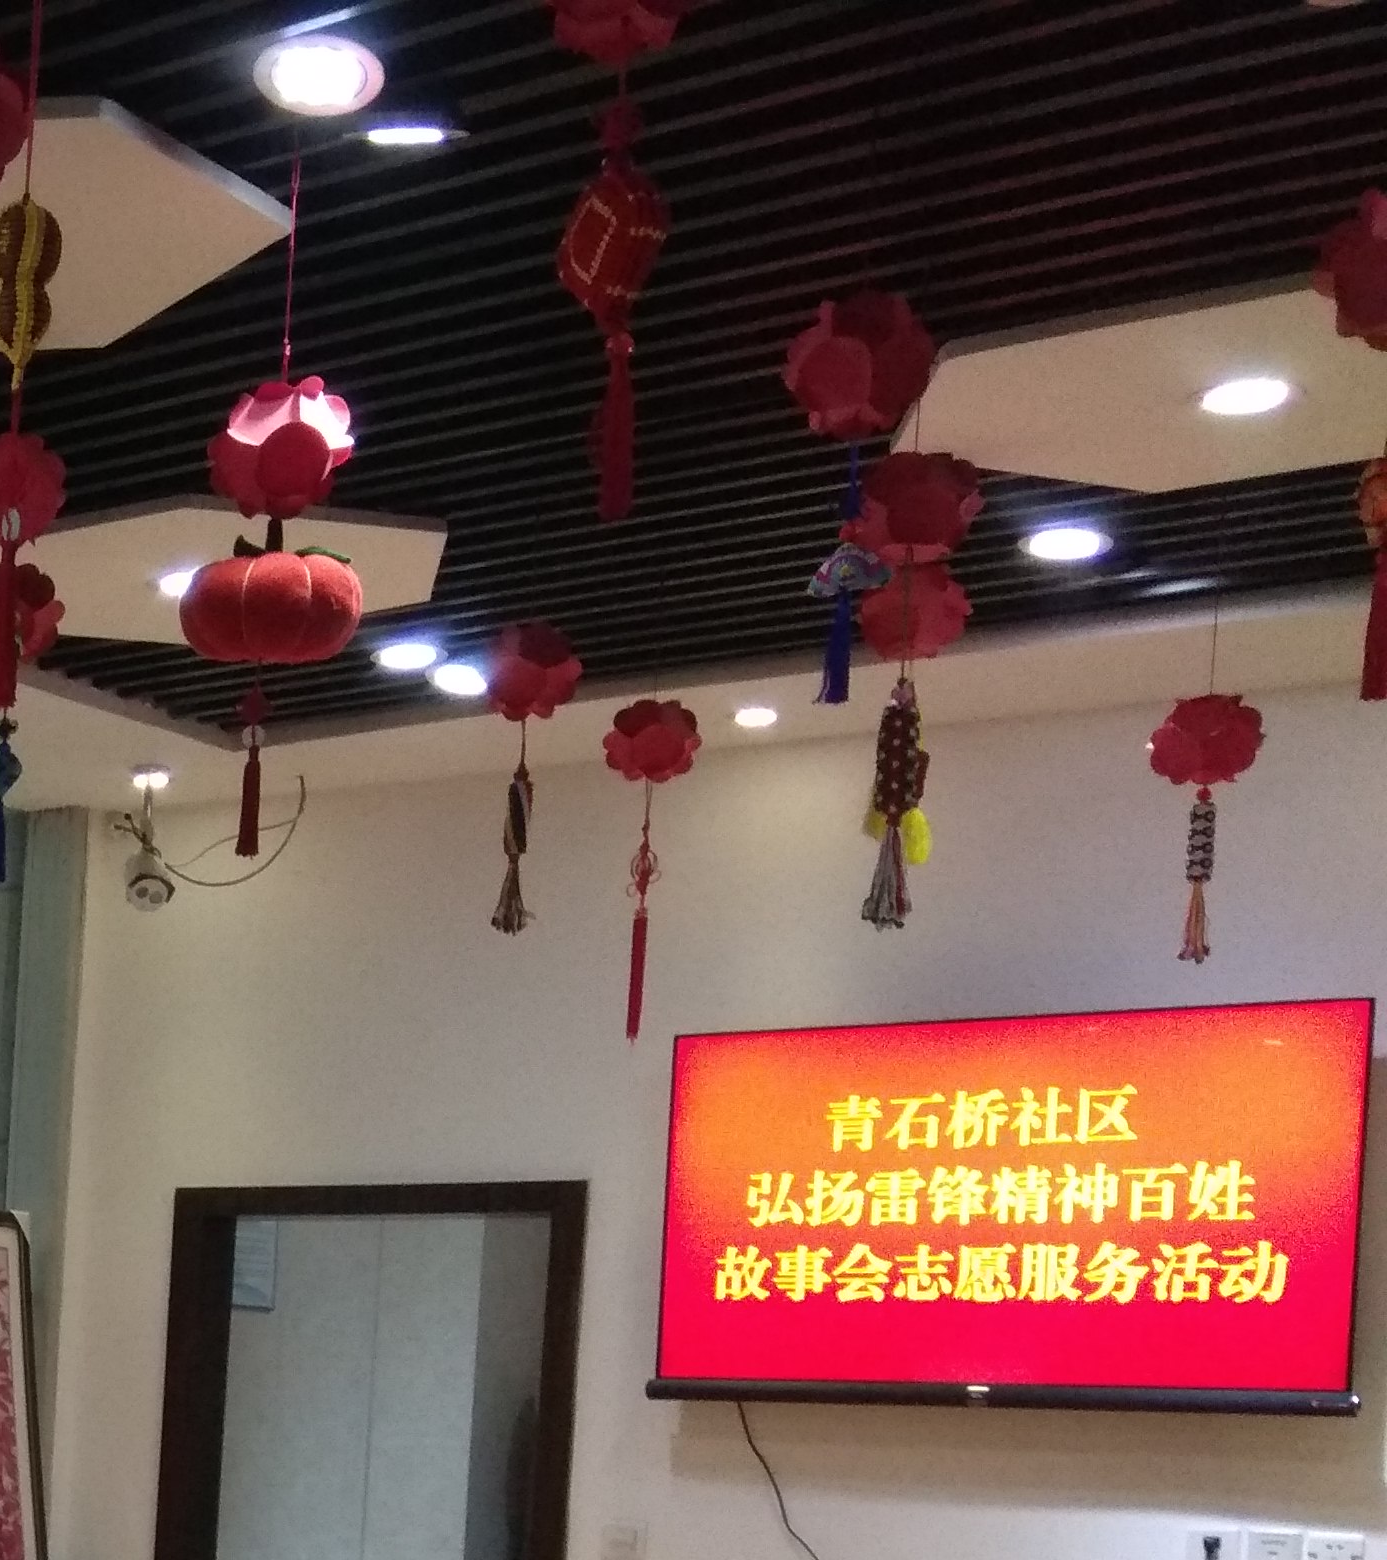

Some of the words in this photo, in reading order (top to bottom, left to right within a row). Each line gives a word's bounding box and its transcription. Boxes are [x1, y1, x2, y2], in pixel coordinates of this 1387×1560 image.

[826, 1084, 1139, 1153] 青石桥社区
[746, 1160, 1255, 1228] 弘扬雷锋精神百姓
[715, 1240, 1289, 1304] 故事会志愿服务活动
